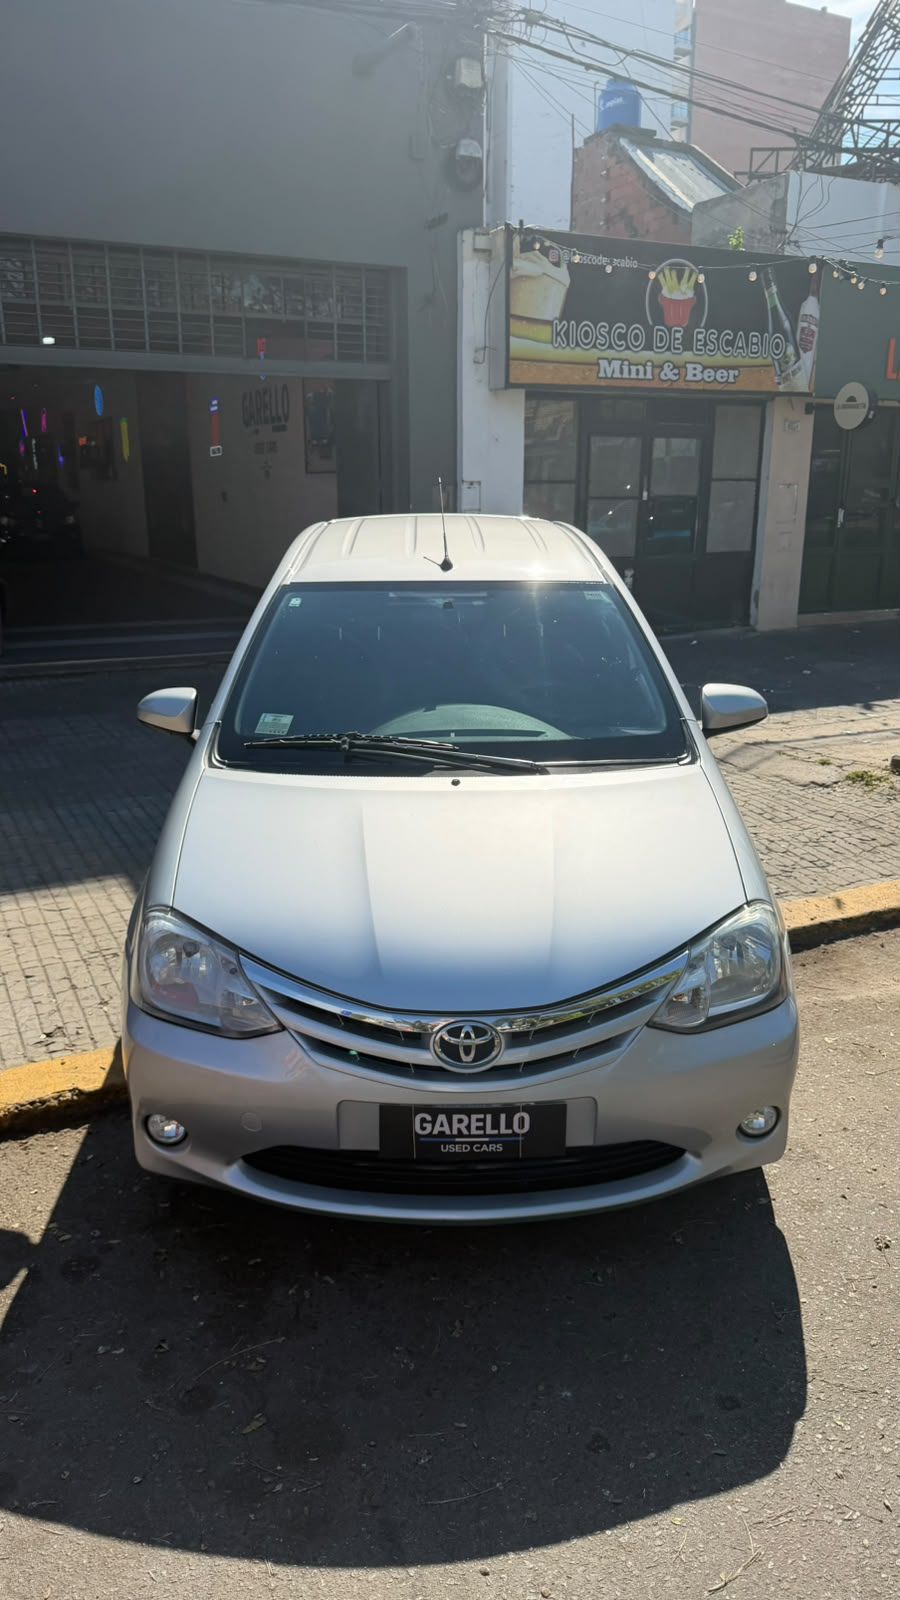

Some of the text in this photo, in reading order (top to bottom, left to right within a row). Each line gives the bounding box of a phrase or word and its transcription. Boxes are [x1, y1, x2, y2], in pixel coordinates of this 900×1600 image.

[552, 320, 645, 351] KIOSCO
[653, 326, 683, 353] DE
[693, 328, 786, 359] ESCABIO
[598, 359, 739, 383] Mini & Beer
[886, 336, 900, 379] L
[242, 383, 289, 428] GARELLO
[414, 1111, 530, 1136] GARELLO
[440, 1143, 503, 1153] USED CARS
